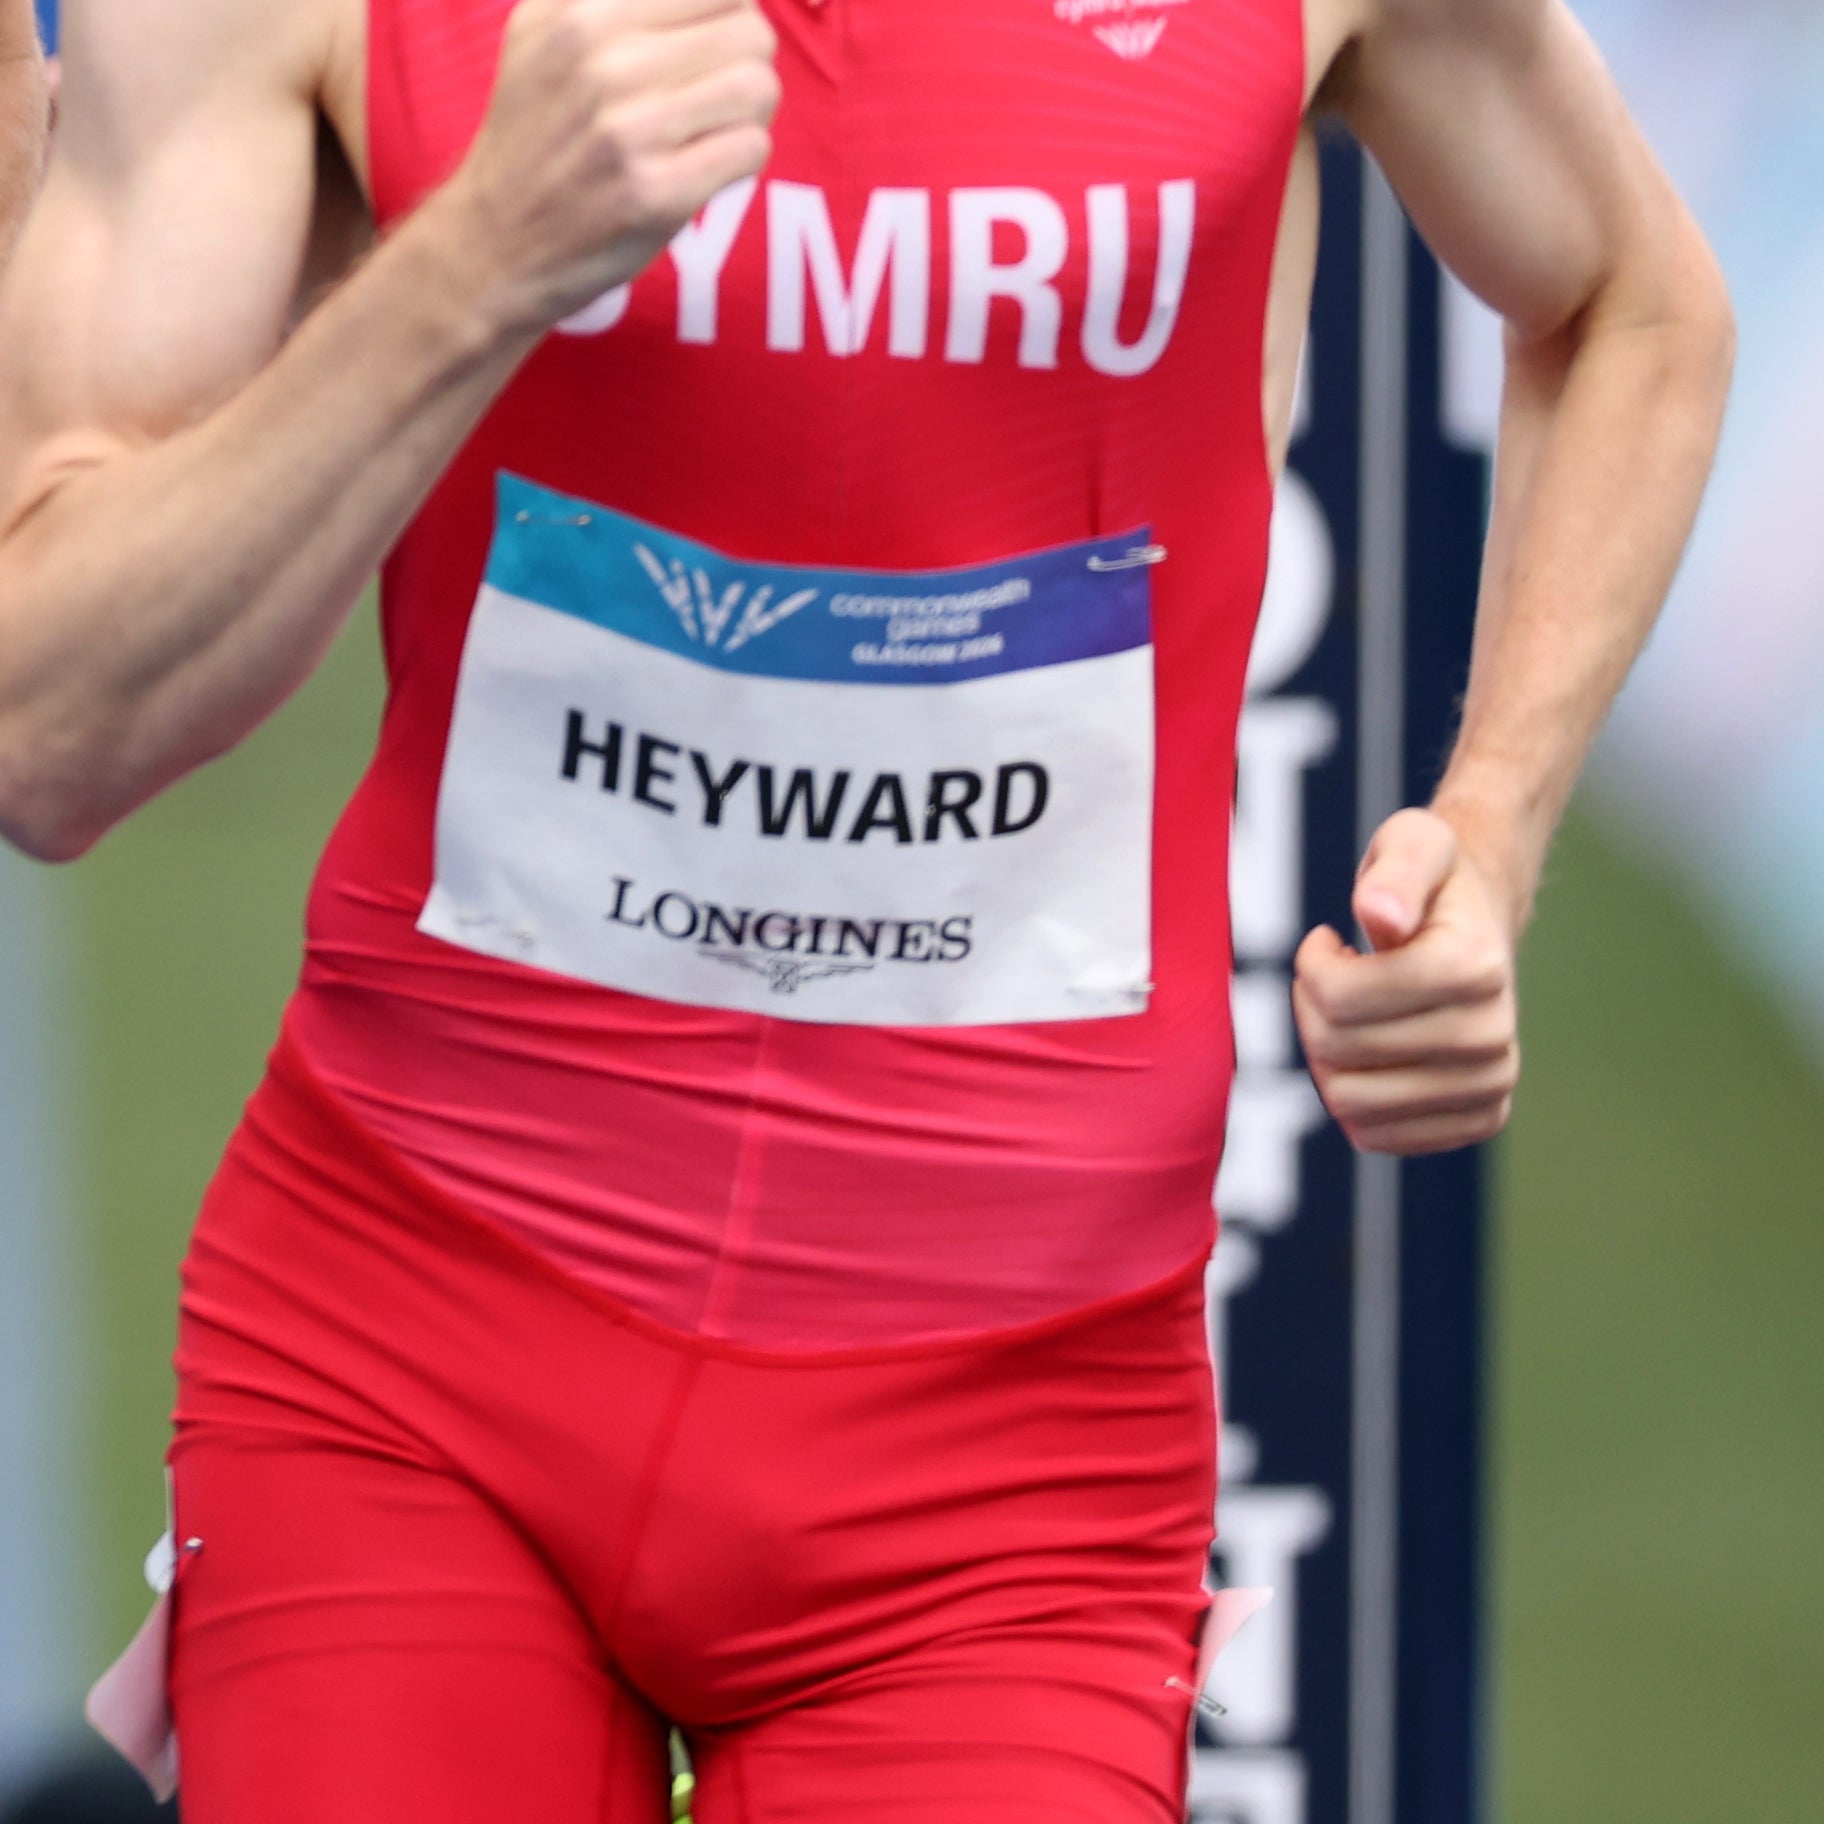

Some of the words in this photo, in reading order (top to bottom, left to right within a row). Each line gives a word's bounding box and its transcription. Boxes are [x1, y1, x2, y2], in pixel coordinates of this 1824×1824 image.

[555, 177, 1197, 377] YMRU
[560, 708, 1051, 844] HEYWARD
[604, 878, 974, 962] LONGINES
